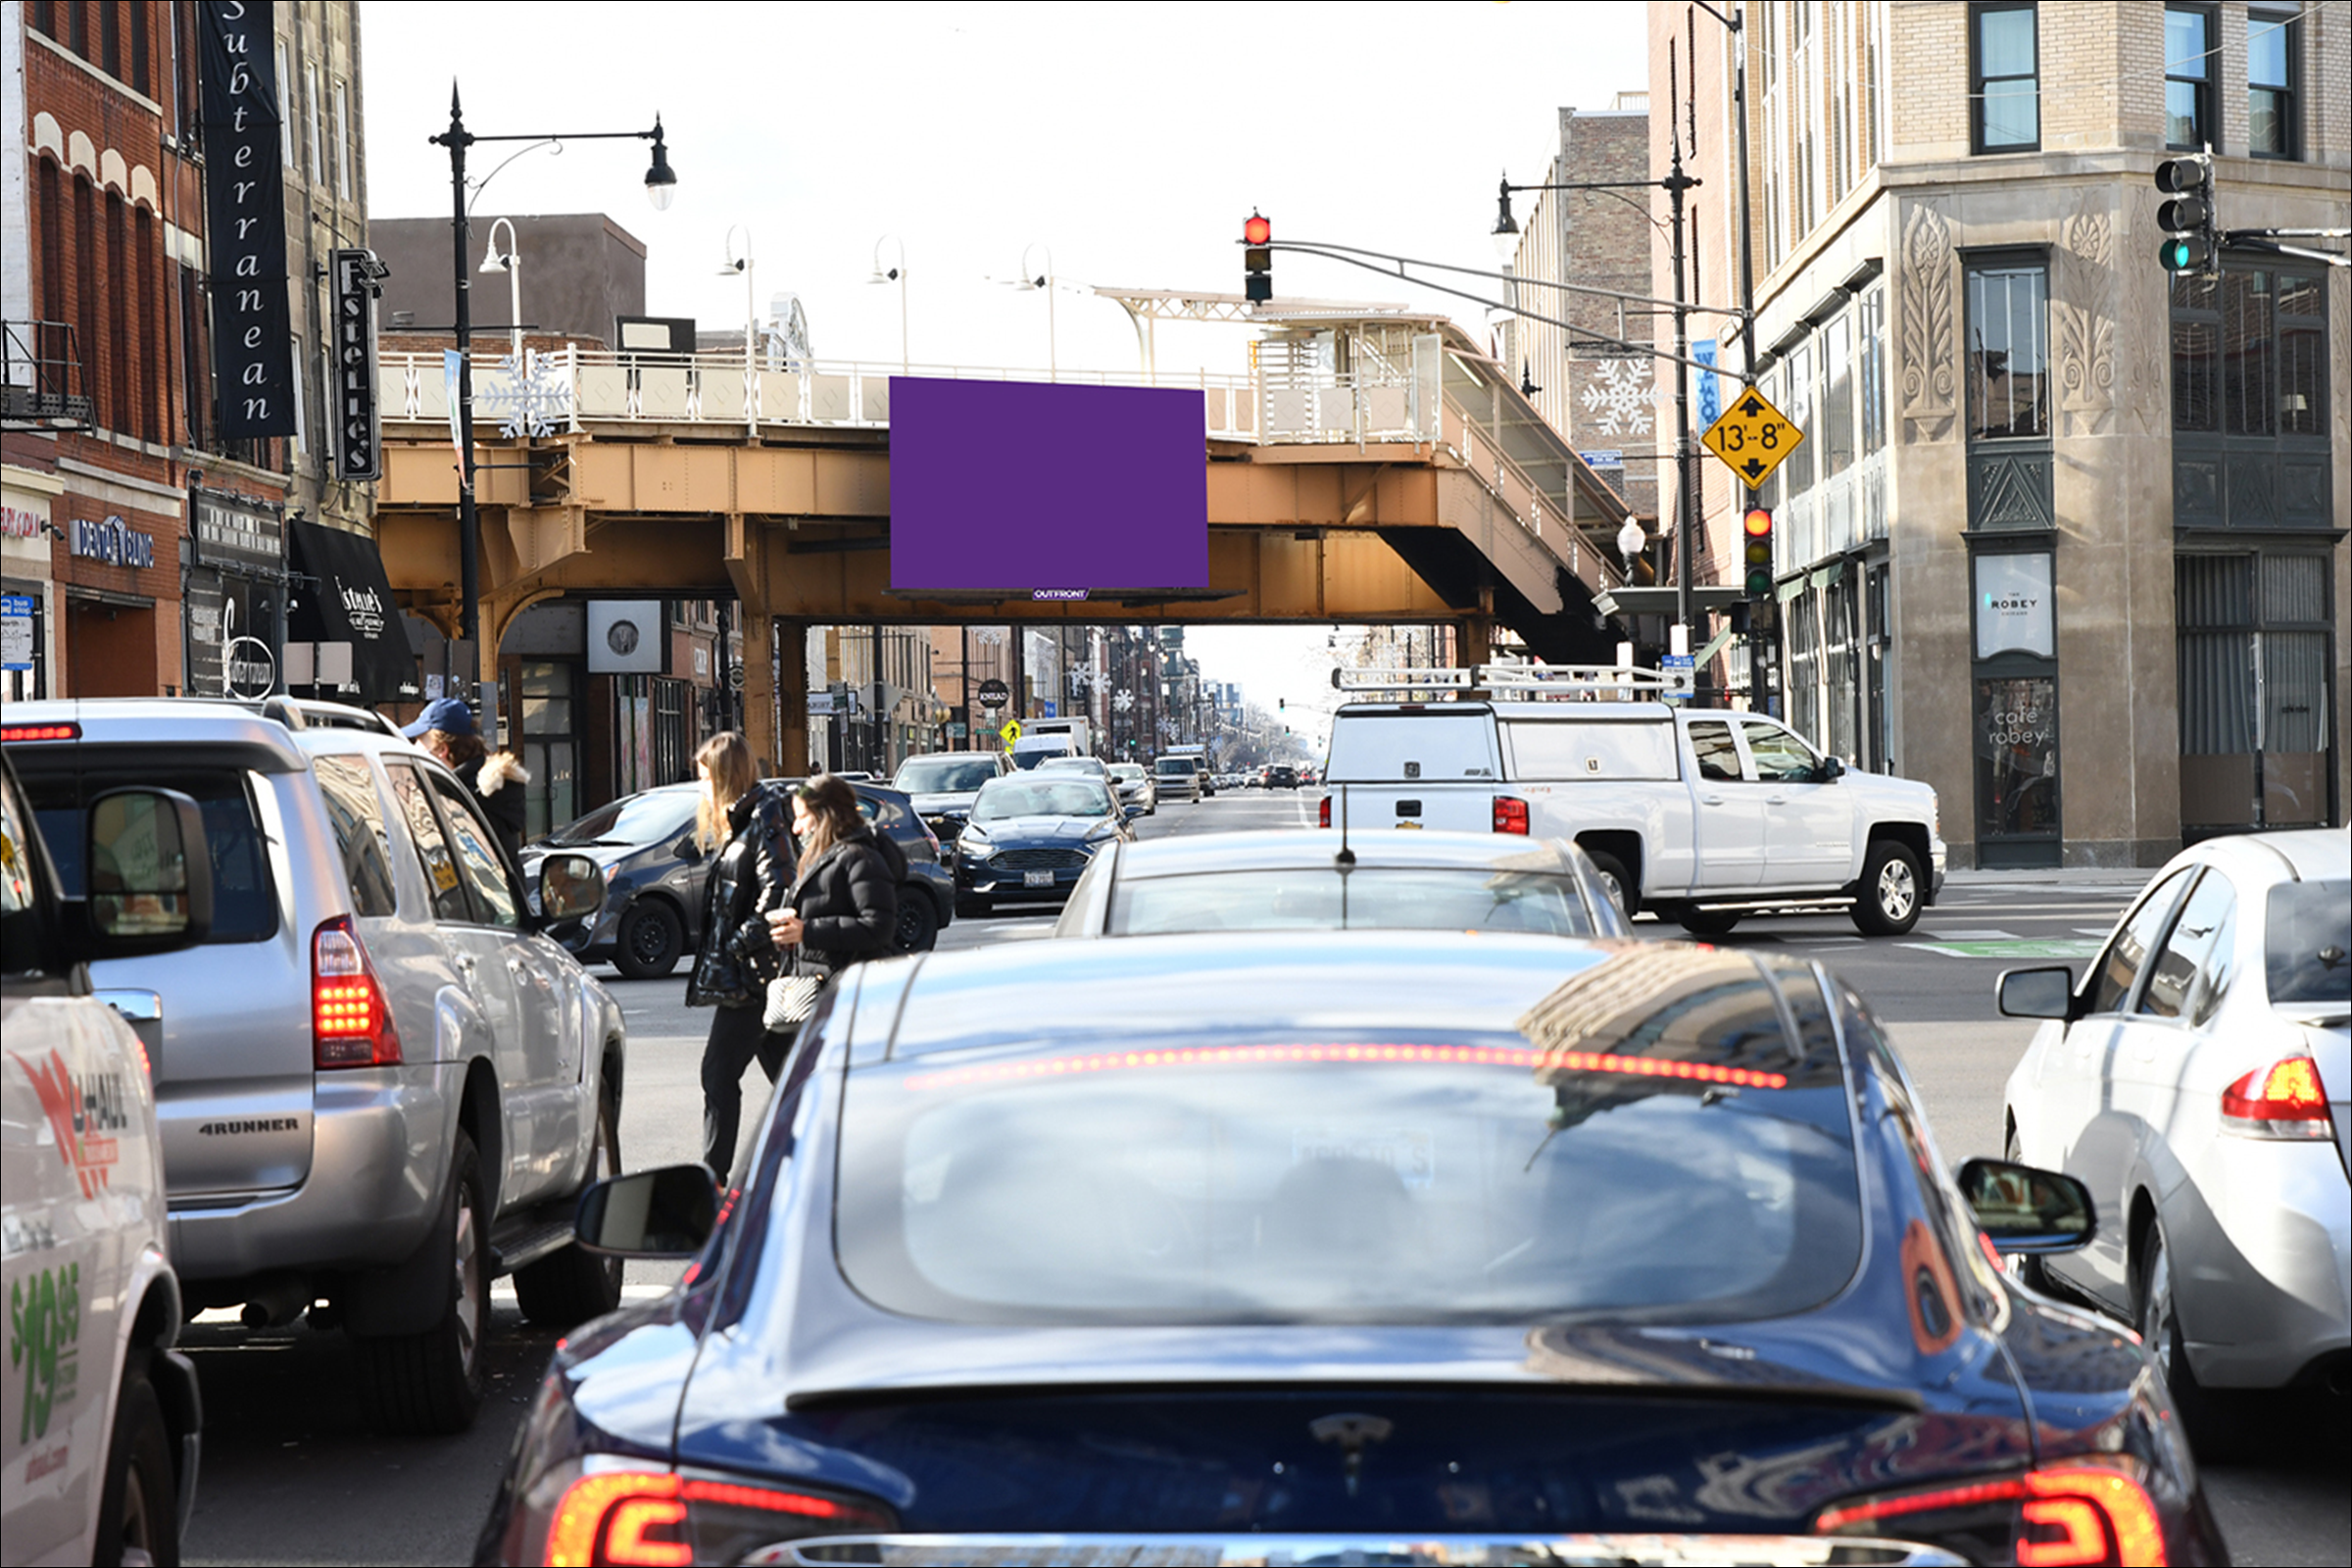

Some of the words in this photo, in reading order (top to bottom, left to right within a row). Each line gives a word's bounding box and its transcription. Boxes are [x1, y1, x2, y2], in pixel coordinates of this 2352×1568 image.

[221, 1, 271, 419] Subterranean
[124, 529, 155, 569] CLINIC
[1033, 589, 1086, 599] OUTFRONT
[1991, 599, 2037, 610] ROBEY
[1988, 726, 2045, 748] robey
[68, 1073, 127, 1132] U-HAUL
[198, 1116, 300, 1136] 4RUNNER
